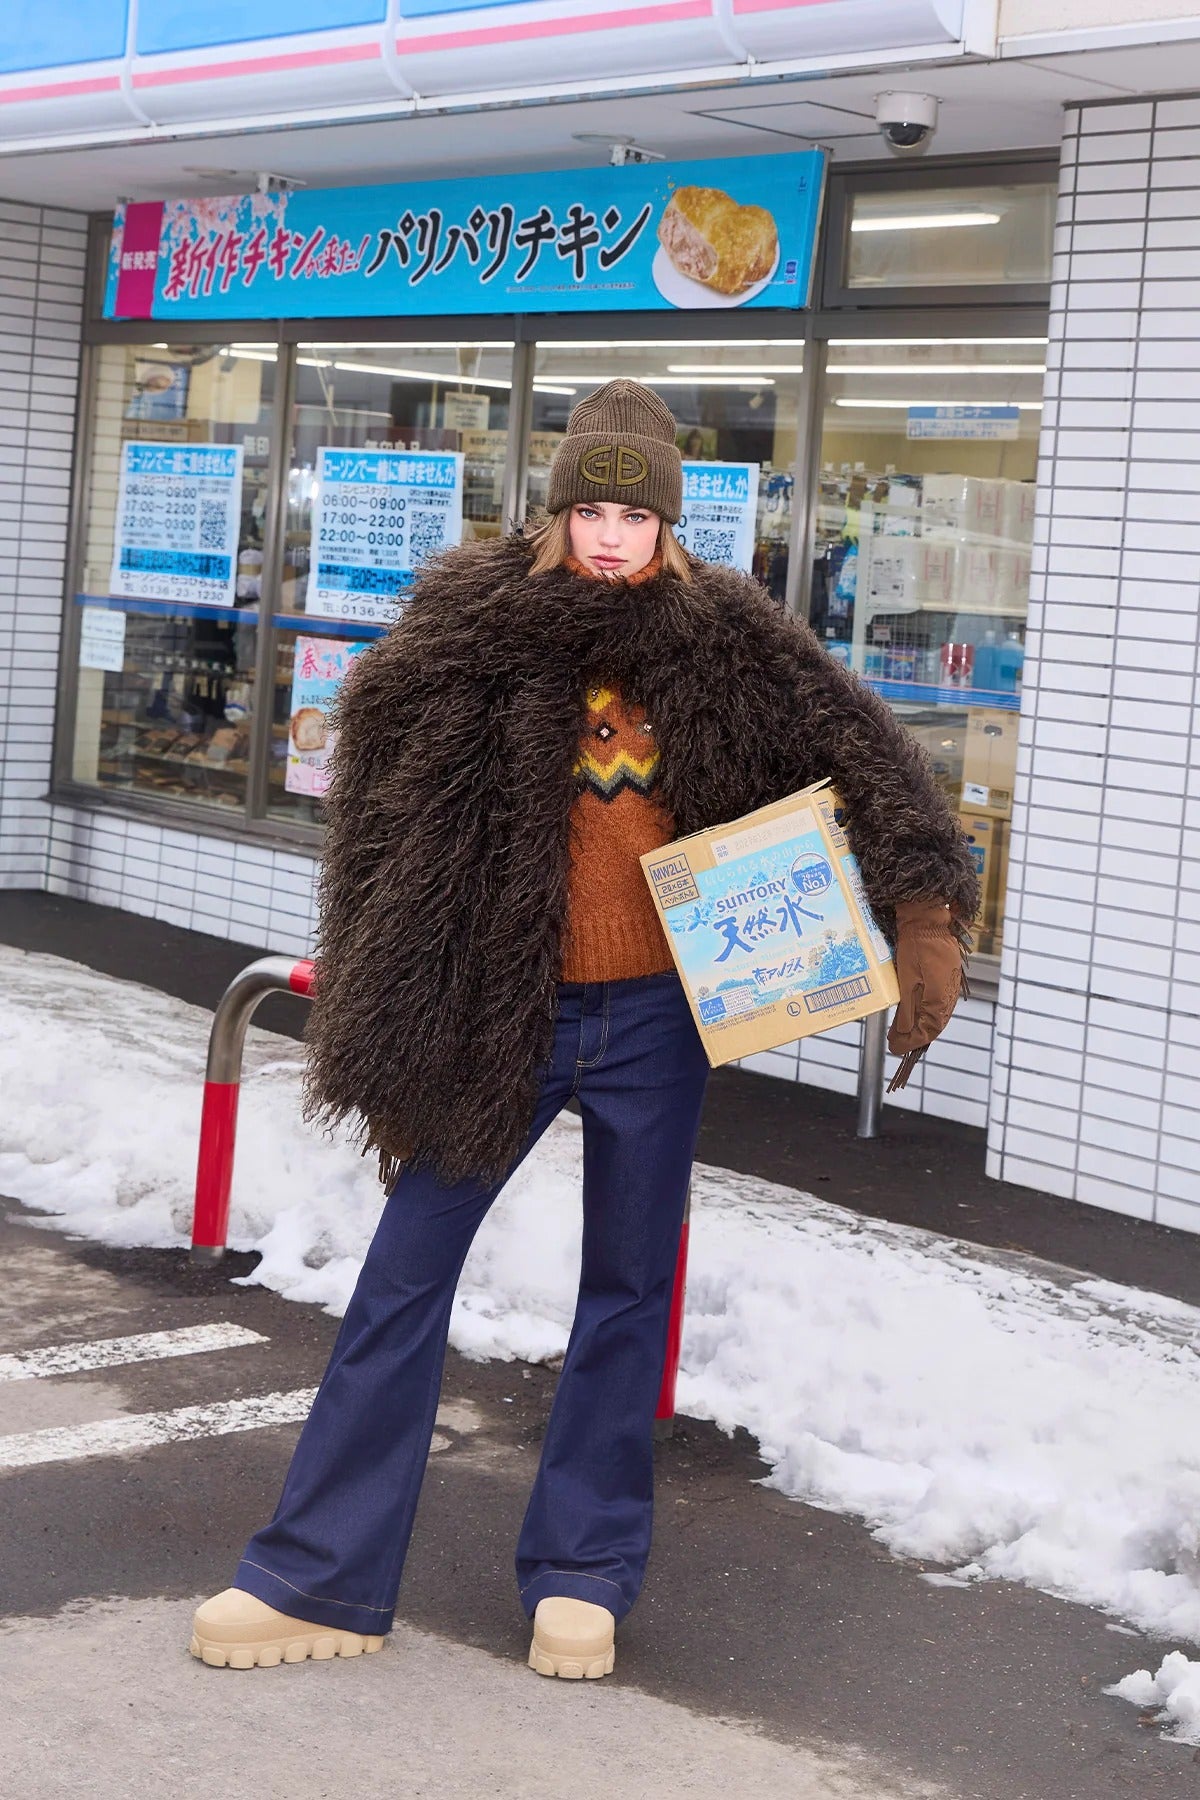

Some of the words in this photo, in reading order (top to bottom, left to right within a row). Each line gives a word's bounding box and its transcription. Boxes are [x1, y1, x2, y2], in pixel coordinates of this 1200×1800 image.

[367, 203, 651, 283] パリパリチキン
[682, 472, 748, 499] きませんか
[651, 860, 687, 882] MW2LL
[802, 874, 828, 892] No.1
[716, 877, 787, 914] SUNTORY
[713, 895, 824, 963] 天然水
[752, 956, 804, 987] 南アルプス
